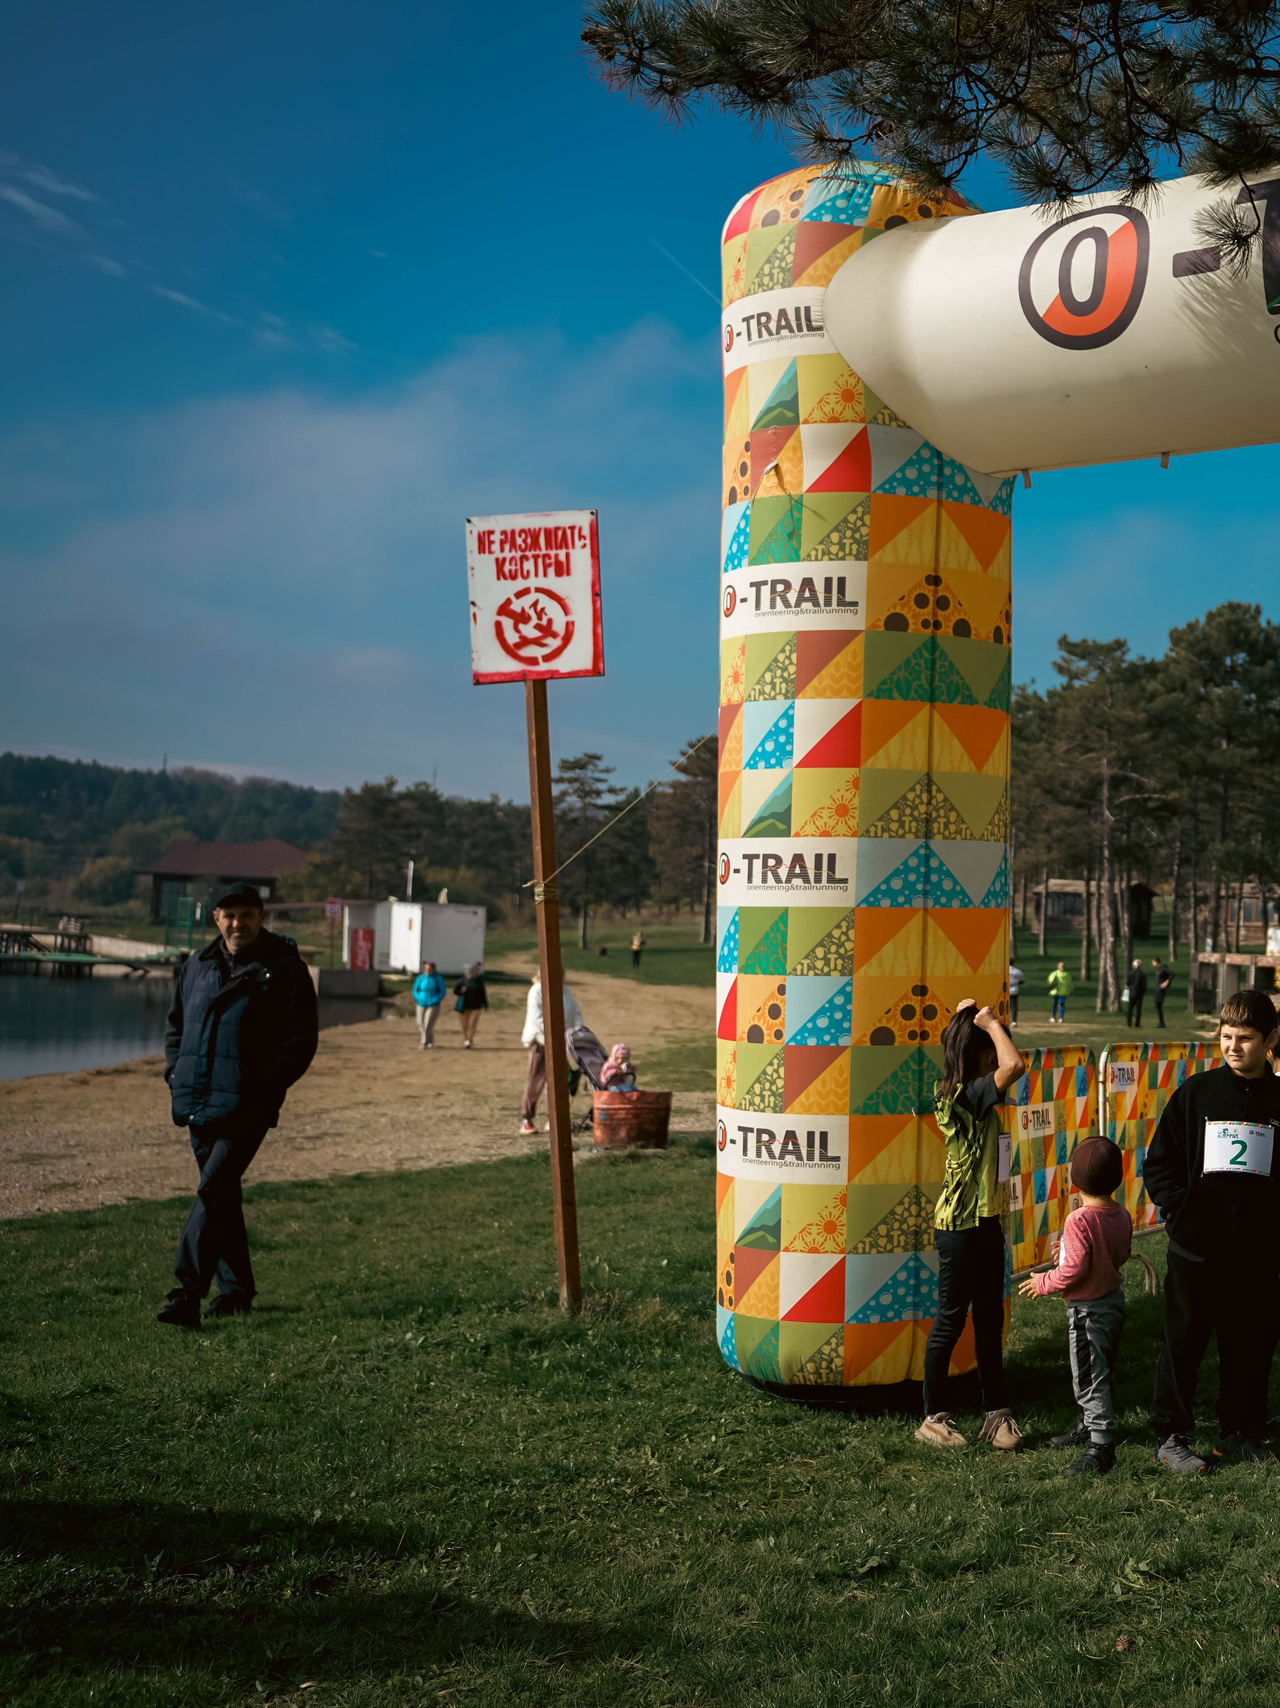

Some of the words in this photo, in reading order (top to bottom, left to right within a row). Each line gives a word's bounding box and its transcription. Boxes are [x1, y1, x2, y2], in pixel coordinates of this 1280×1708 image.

[477, 529, 496, 555] НЕ
[499, 525, 587, 554] РАЗЖИГАТЬ
[494, 551, 572, 582] КОСТРЫ
[754, 606, 859, 618] orienteering&trailrunning
[747, 884, 849, 893] orienteering&trailrunning
[1229, 1139, 1248, 1166] 2
[742, 1157, 841, 1170] orienteering&trailrunning
